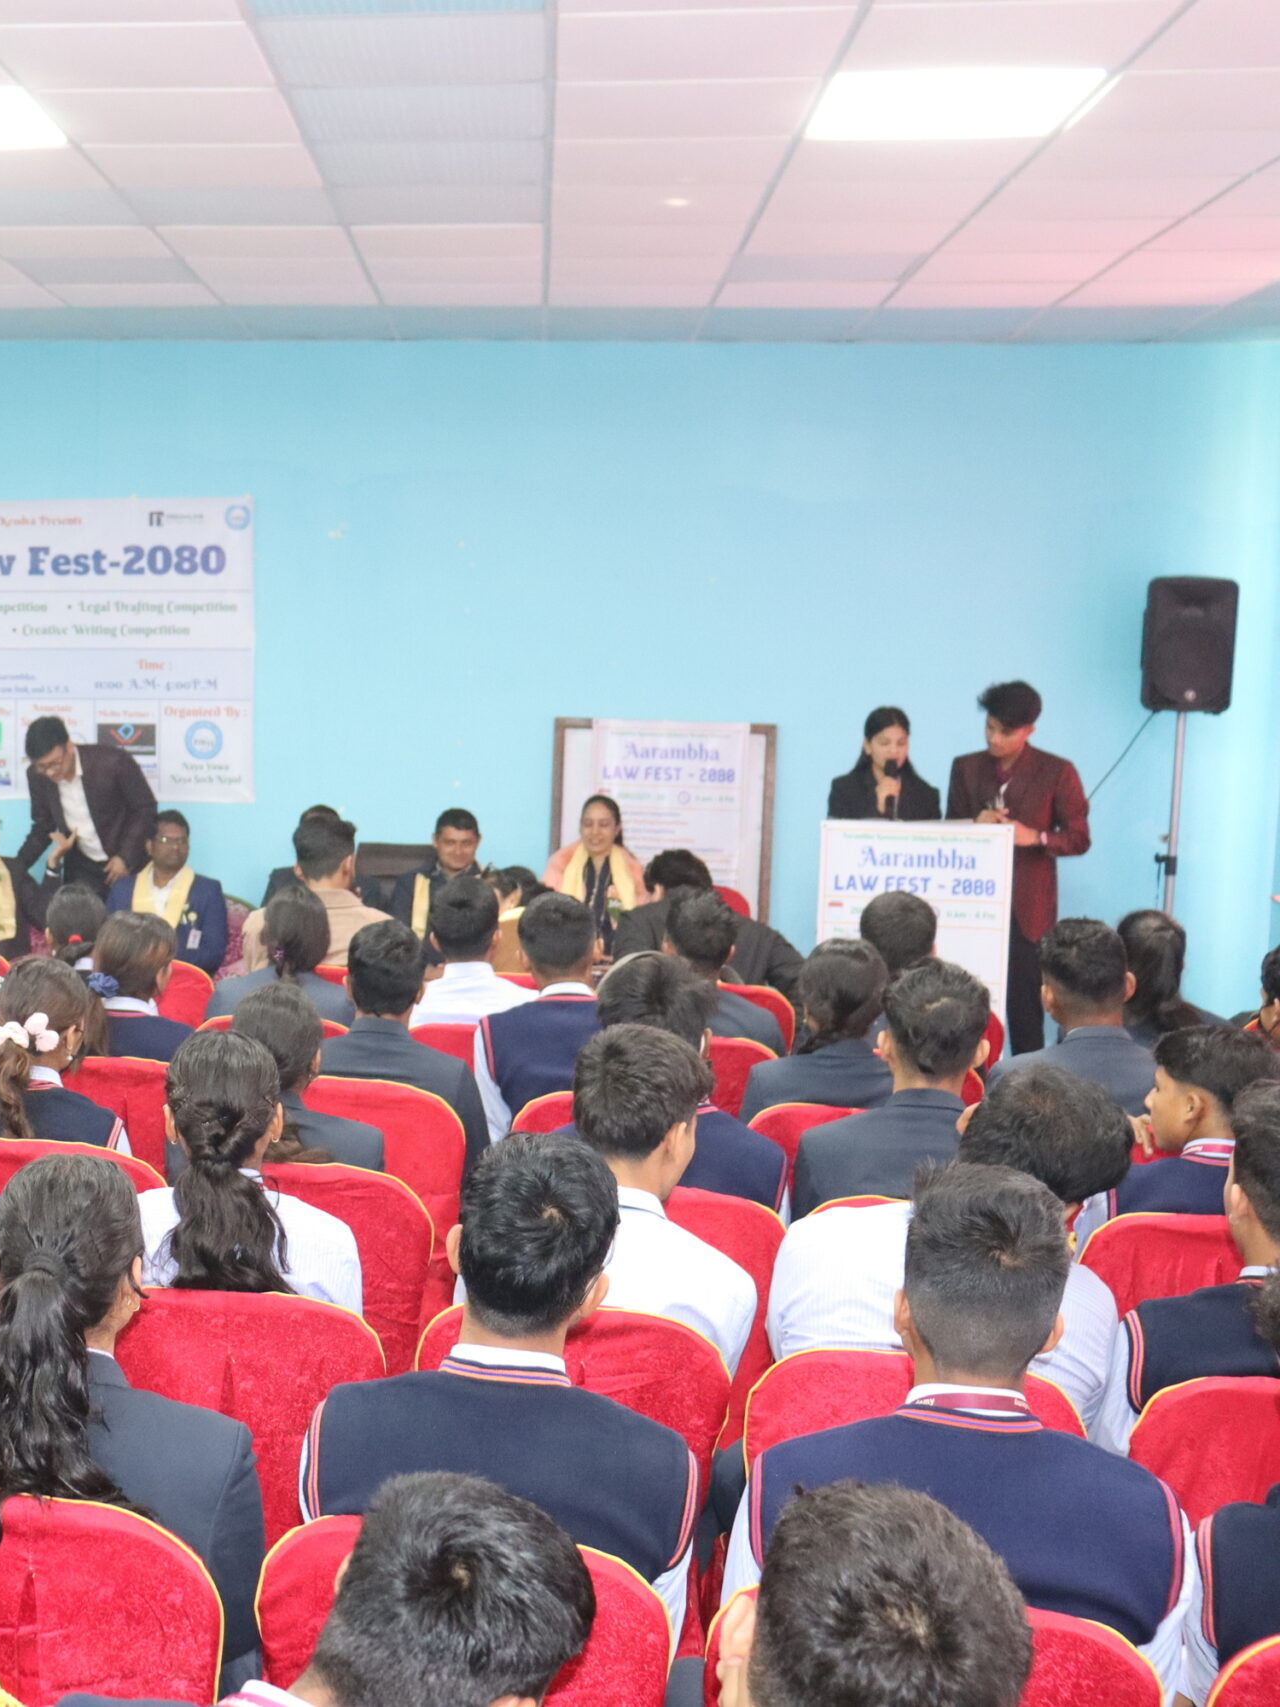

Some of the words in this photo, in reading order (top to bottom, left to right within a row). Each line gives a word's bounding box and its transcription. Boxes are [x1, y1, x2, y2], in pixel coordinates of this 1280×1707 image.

[27, 544, 227, 577] Fest-2080
[78, 601, 111, 615] Legal
[113, 601, 164, 615] Drafting
[166, 601, 237, 615] Competition
[22, 624, 68, 636] Creative
[72, 624, 118, 637] Writing
[120, 624, 190, 637] Competition
[135, 659, 165, 671] Time
[164, 705, 220, 719] Organized
[224, 705, 241, 719] By
[623, 742, 720, 762] Aarambha
[602, 766, 640, 780] LAW
[644, 767, 683, 782] FEST
[858, 846, 977, 870] Aarambha
[834, 875, 879, 891] LAW
[884, 875, 932, 893] FEST
